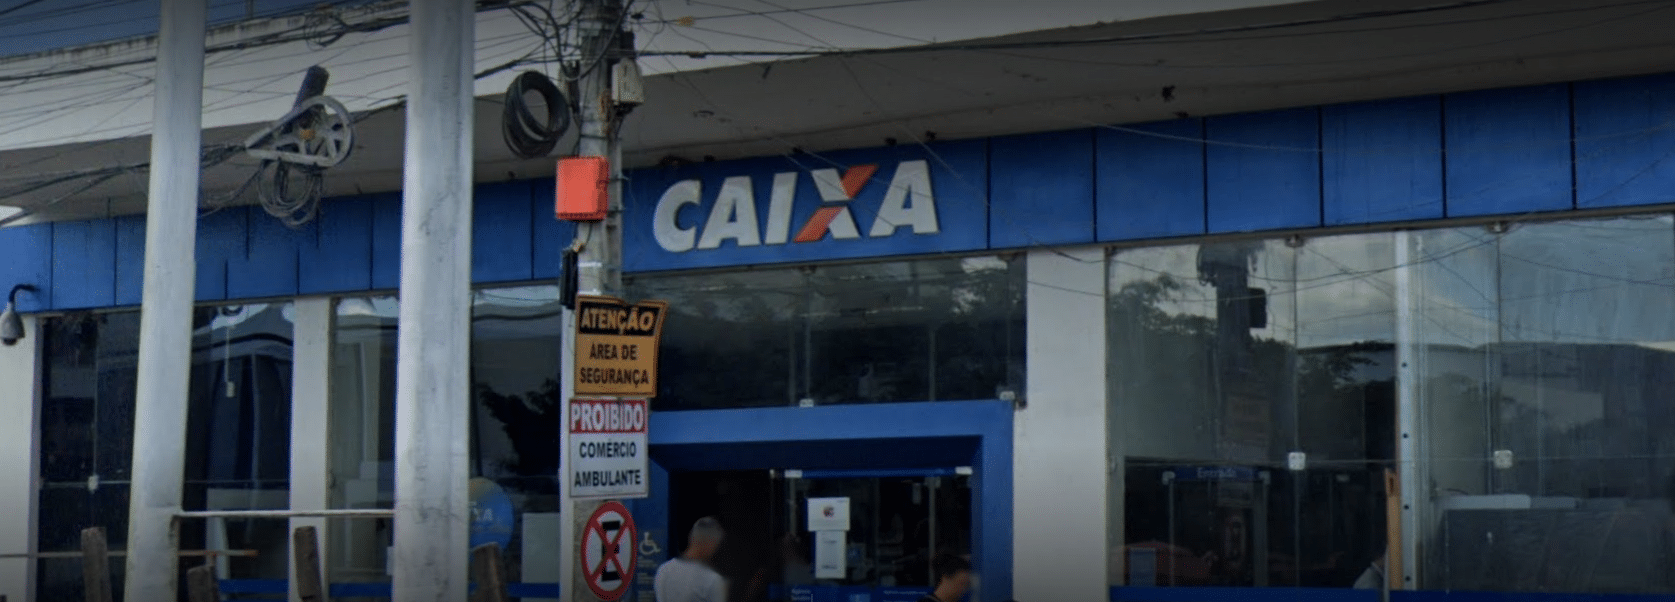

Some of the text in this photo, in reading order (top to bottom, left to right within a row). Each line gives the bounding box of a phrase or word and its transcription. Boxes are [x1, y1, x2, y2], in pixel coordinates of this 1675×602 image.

[653, 160, 940, 253] CAIXA
[581, 305, 655, 335] ATENÇÃO
[621, 343, 637, 360] DE
[580, 367, 650, 388] SEGURANÇA
[570, 402, 644, 432] PROIBIDO
[579, 439, 637, 458] COMÉRCIO
[574, 469, 642, 488] AMBULANTE
